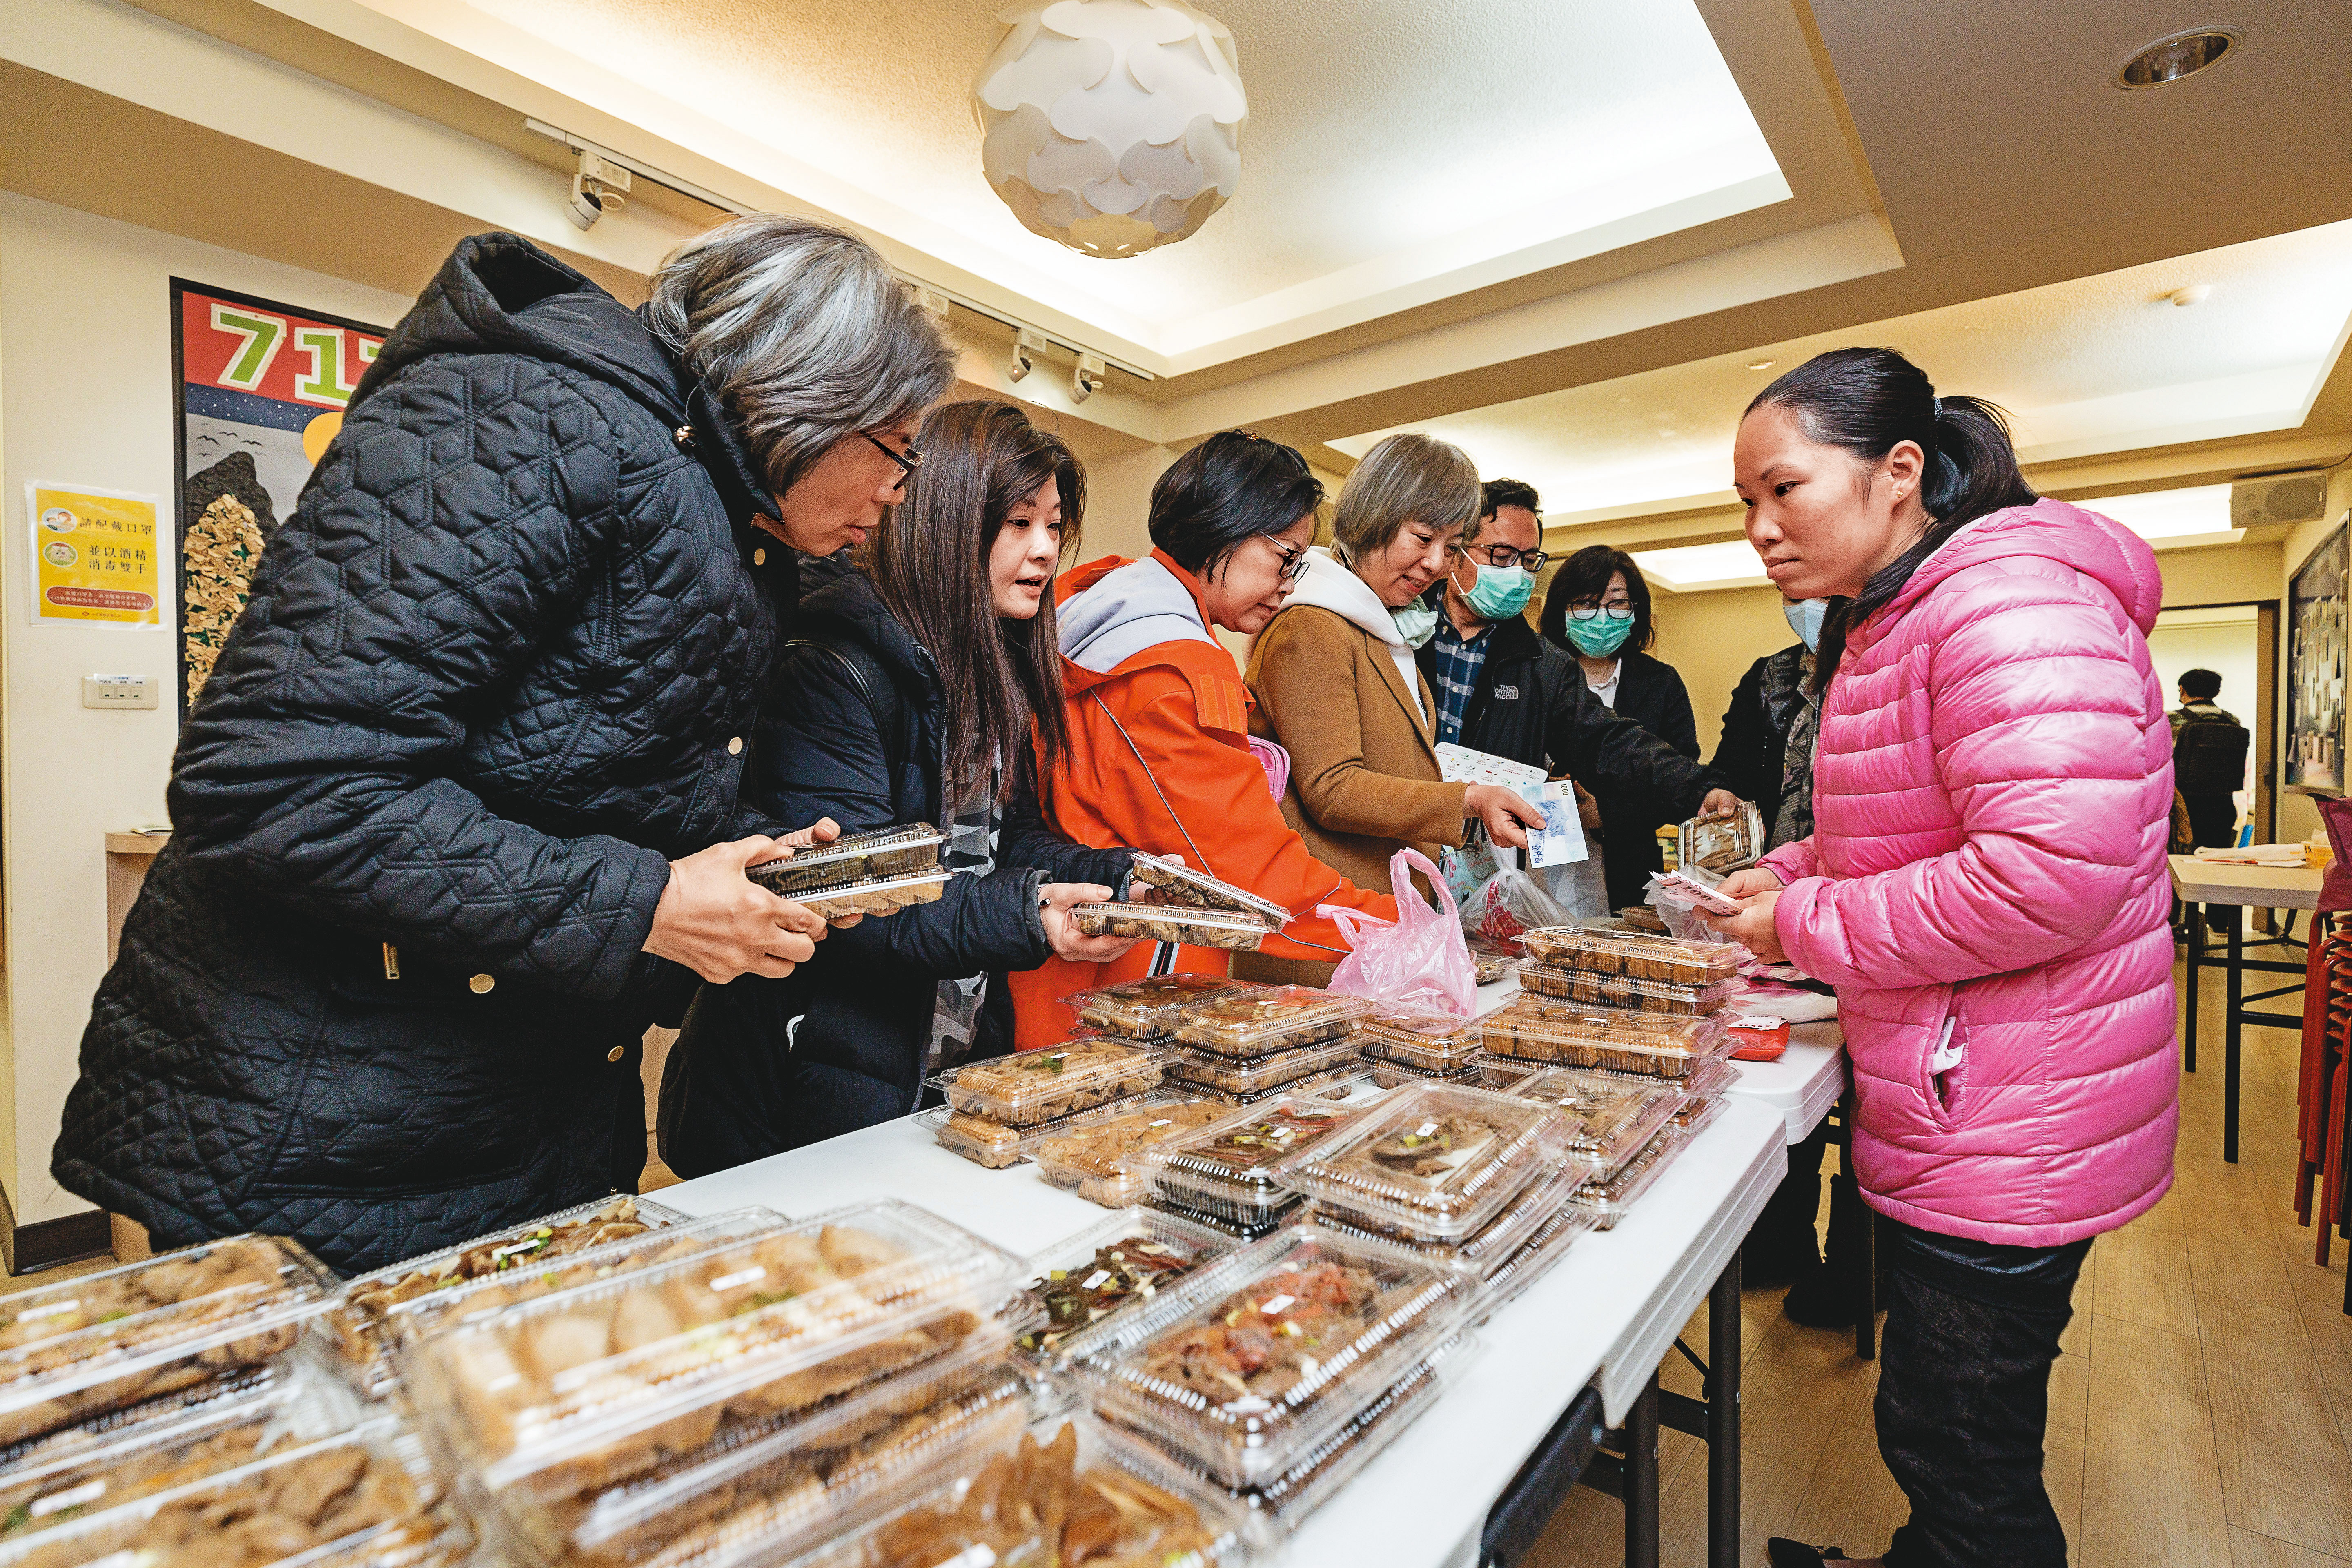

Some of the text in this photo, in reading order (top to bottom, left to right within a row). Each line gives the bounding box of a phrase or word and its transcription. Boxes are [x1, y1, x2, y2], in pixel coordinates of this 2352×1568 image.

[89, 545, 146, 561] 並以酒精
[1560, 784, 1569, 795] 1000
